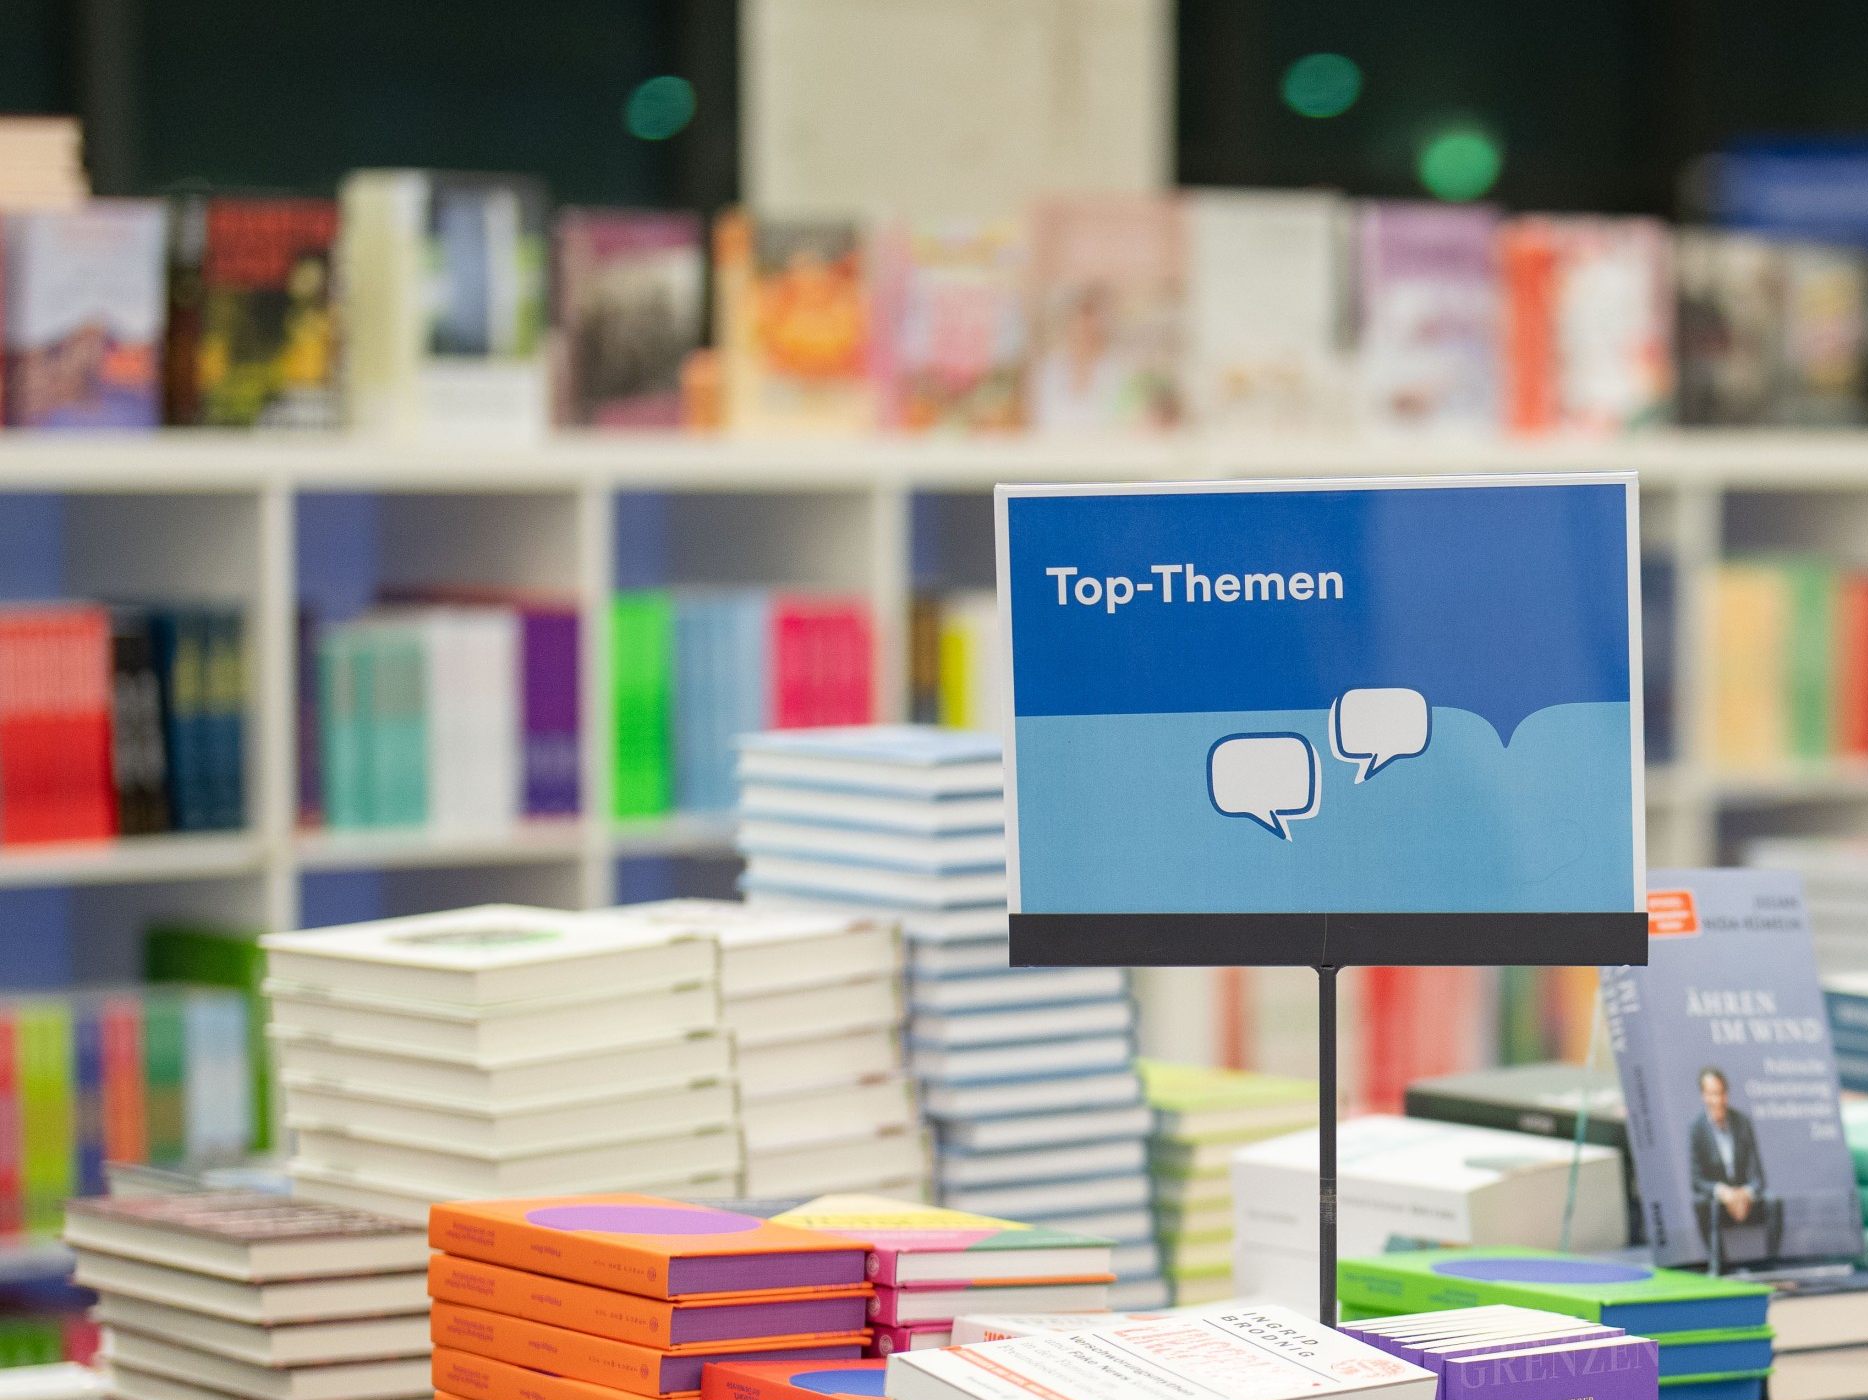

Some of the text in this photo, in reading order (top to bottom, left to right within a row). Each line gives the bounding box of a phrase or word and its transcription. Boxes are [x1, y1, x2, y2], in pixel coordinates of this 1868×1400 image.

[1046, 564, 1345, 613] Top-Themen
[1711, 1020, 1746, 1044] IM
[1749, 1018, 1823, 1043] WIND
[1220, 1314, 1317, 1358] BRODNIG
[1241, 1312, 1321, 1346] INGRID
[1066, 1349, 1133, 1382] Fake News
